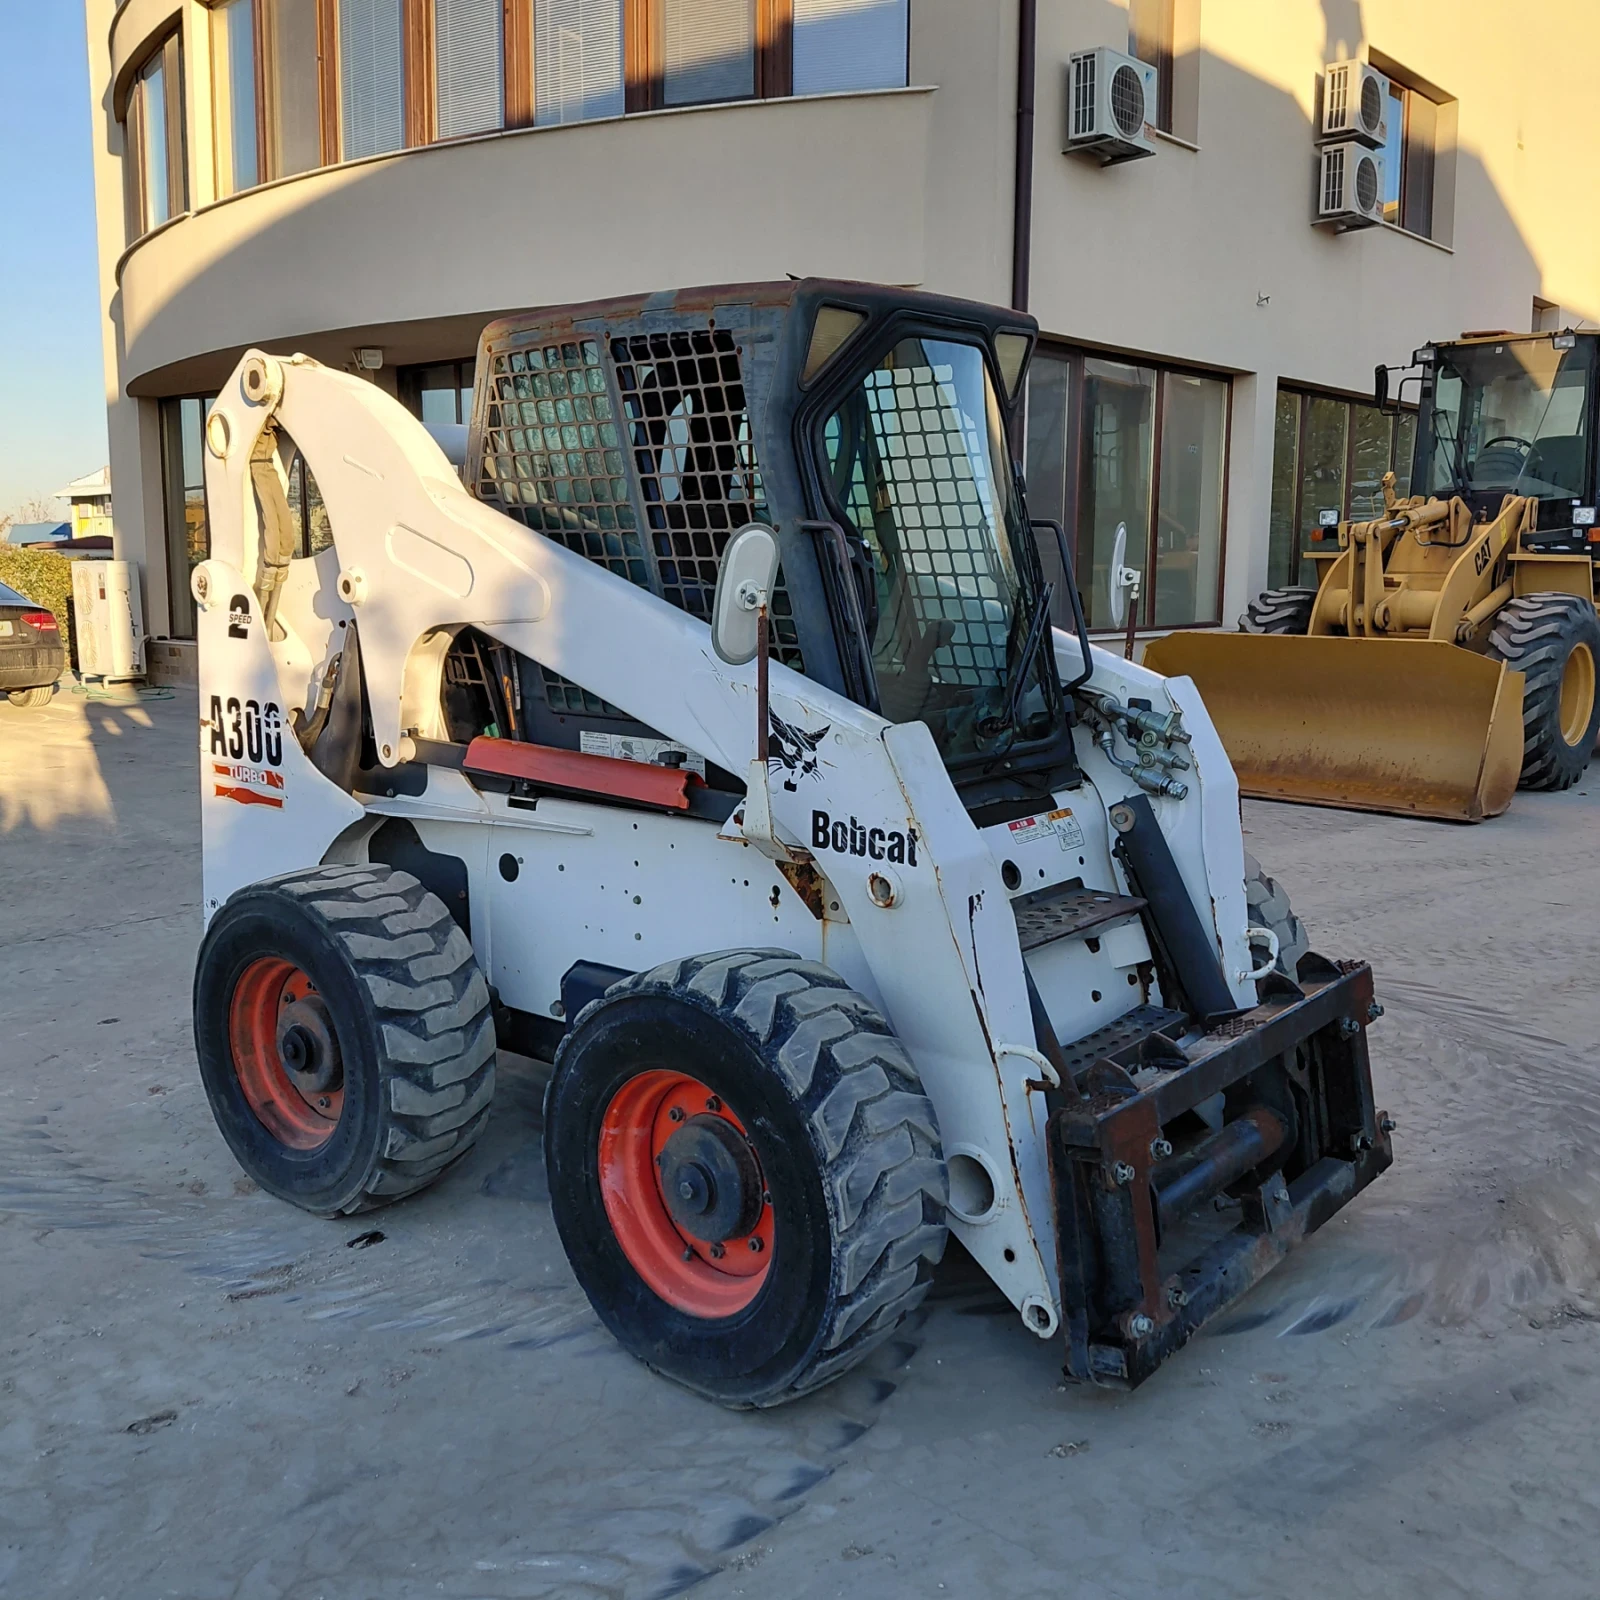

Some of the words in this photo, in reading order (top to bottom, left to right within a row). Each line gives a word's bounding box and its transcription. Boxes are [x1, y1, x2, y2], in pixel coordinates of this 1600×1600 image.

[1475, 536, 1491, 576] CAT
[228, 594, 250, 639] 2
[229, 613, 252, 625] SPEED
[211, 695, 282, 767] A300
[228, 766, 268, 785] TURBO
[812, 809, 918, 867] Bobcat
